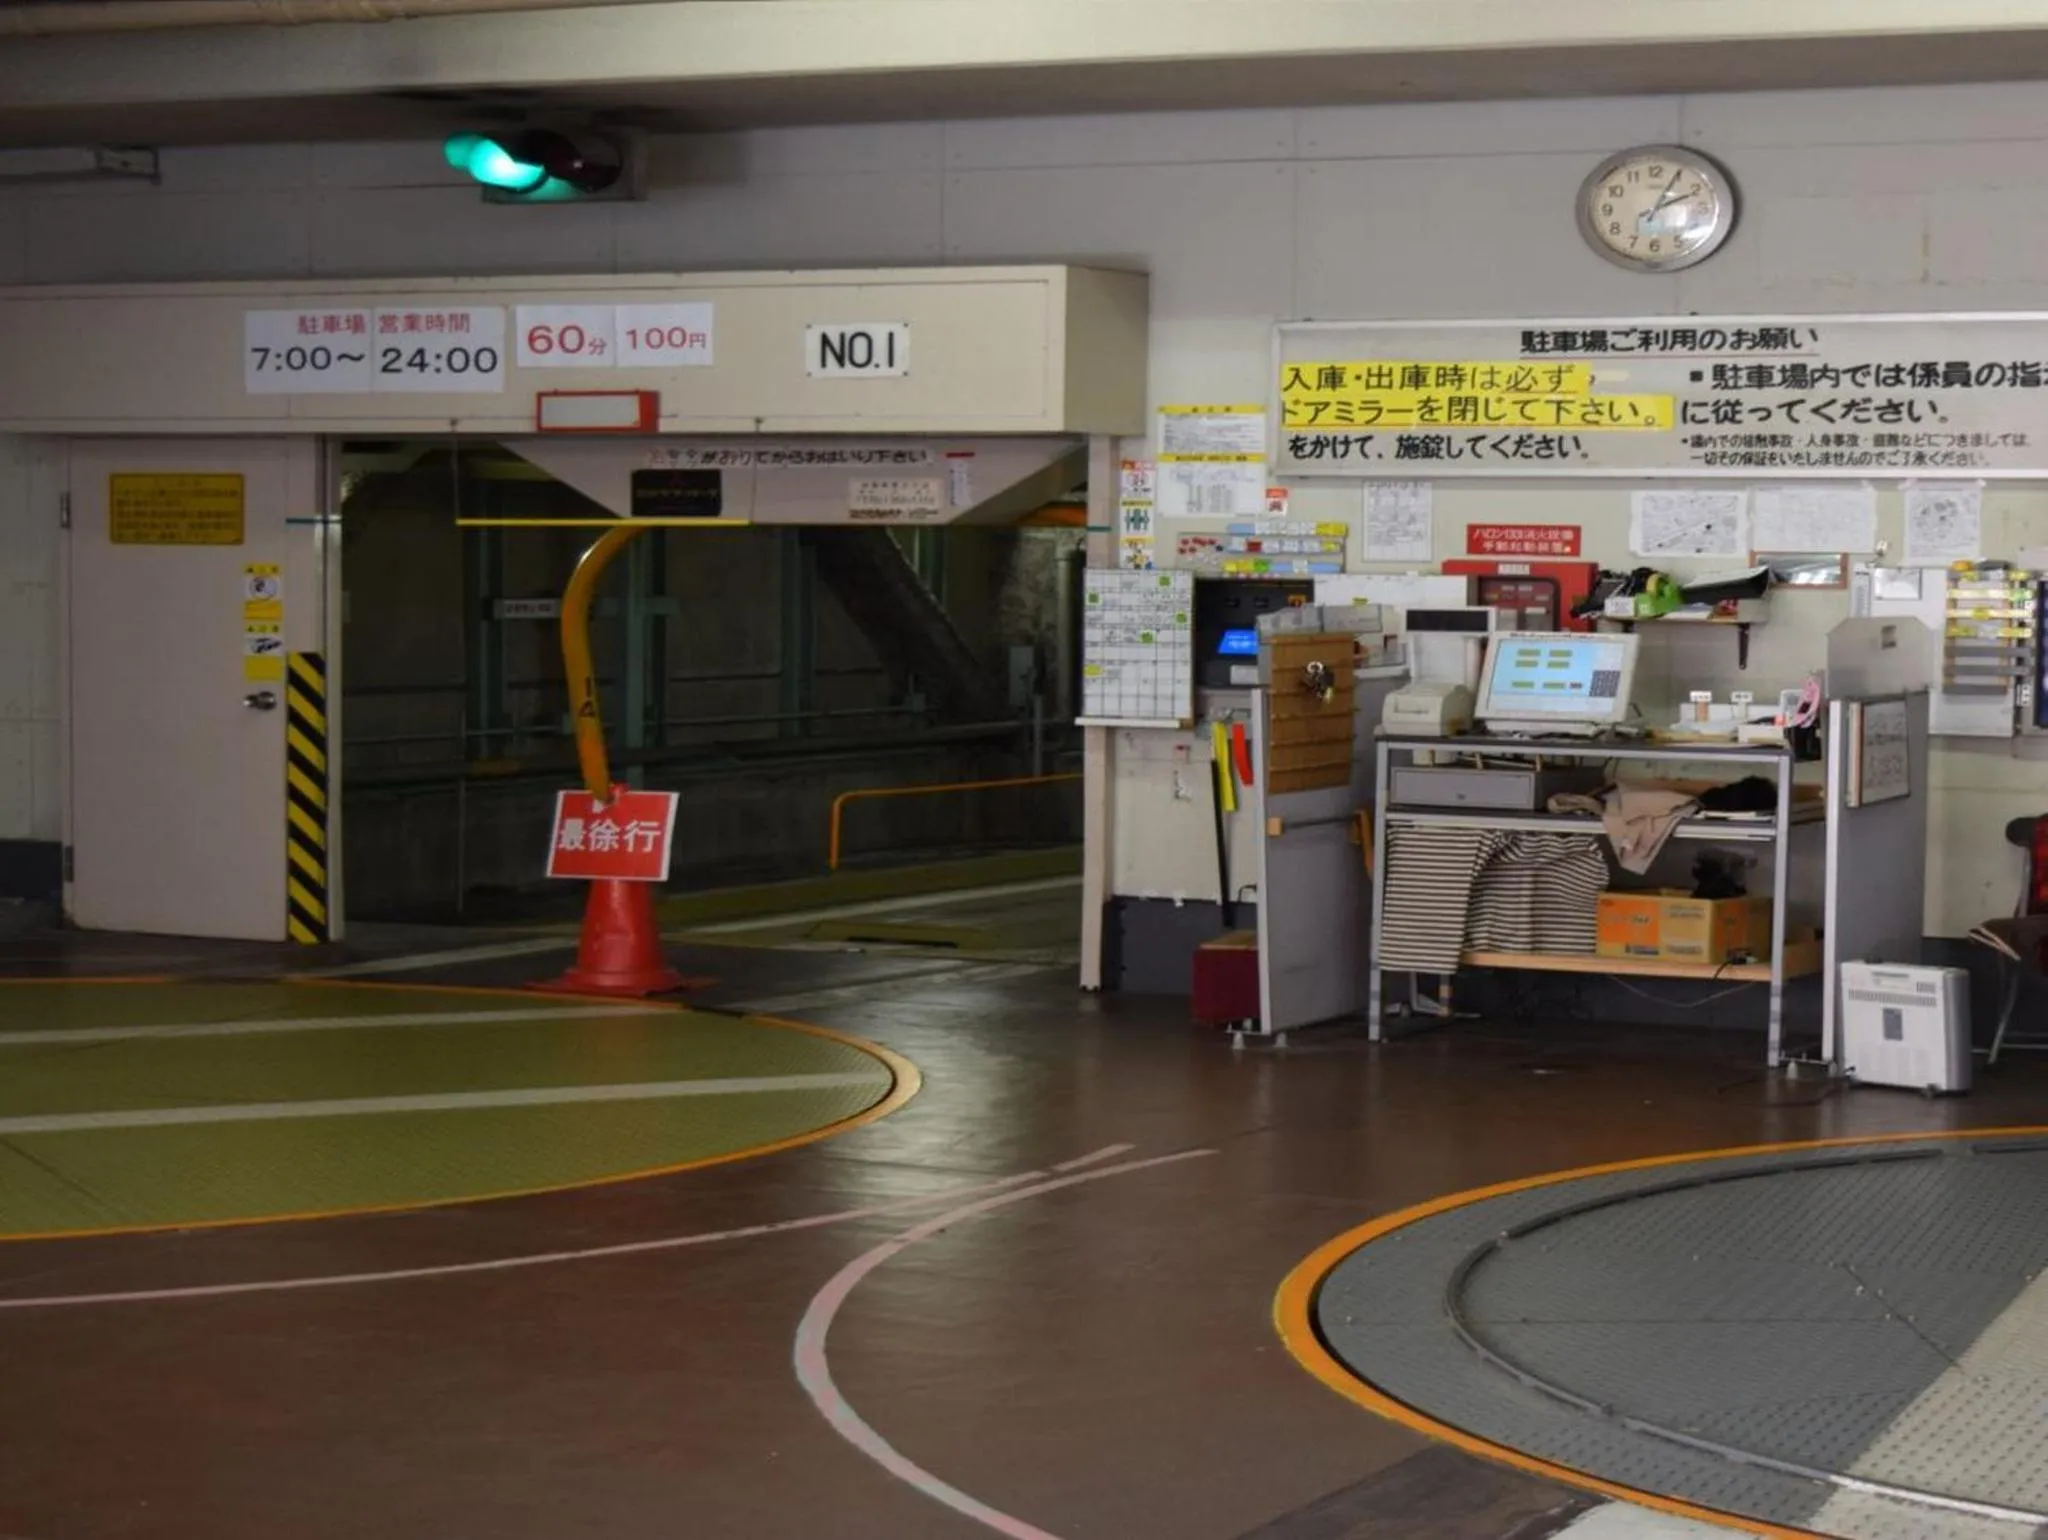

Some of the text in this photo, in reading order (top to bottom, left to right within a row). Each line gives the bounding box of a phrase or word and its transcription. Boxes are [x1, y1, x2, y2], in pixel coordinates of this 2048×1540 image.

[1627, 170, 1640, 184] 11
[1648, 164, 1664, 179] 12
[1608, 184, 1625, 198] 10
[1602, 203, 1613, 217] 9
[1609, 221, 1621, 235] 8
[1629, 235, 1639, 249] 7
[1649, 239, 1661, 252] 6
[1673, 234, 1684, 248] 5
[297, 313, 471, 335] 駐車場 営業時間
[527, 324, 706, 356] 60分 100円
[1520, 328, 1819, 353] 駐車場ご利用のお願い
[380, 346, 499, 374] 24:00
[1711, 360, 2048, 391] 駐車場内では係員の指
[1281, 396, 1657, 427] ドアミラーを閉じて下さい。
[1681, 397, 1949, 425] に従ってください。
[558, 817, 662, 853] 最徐行
